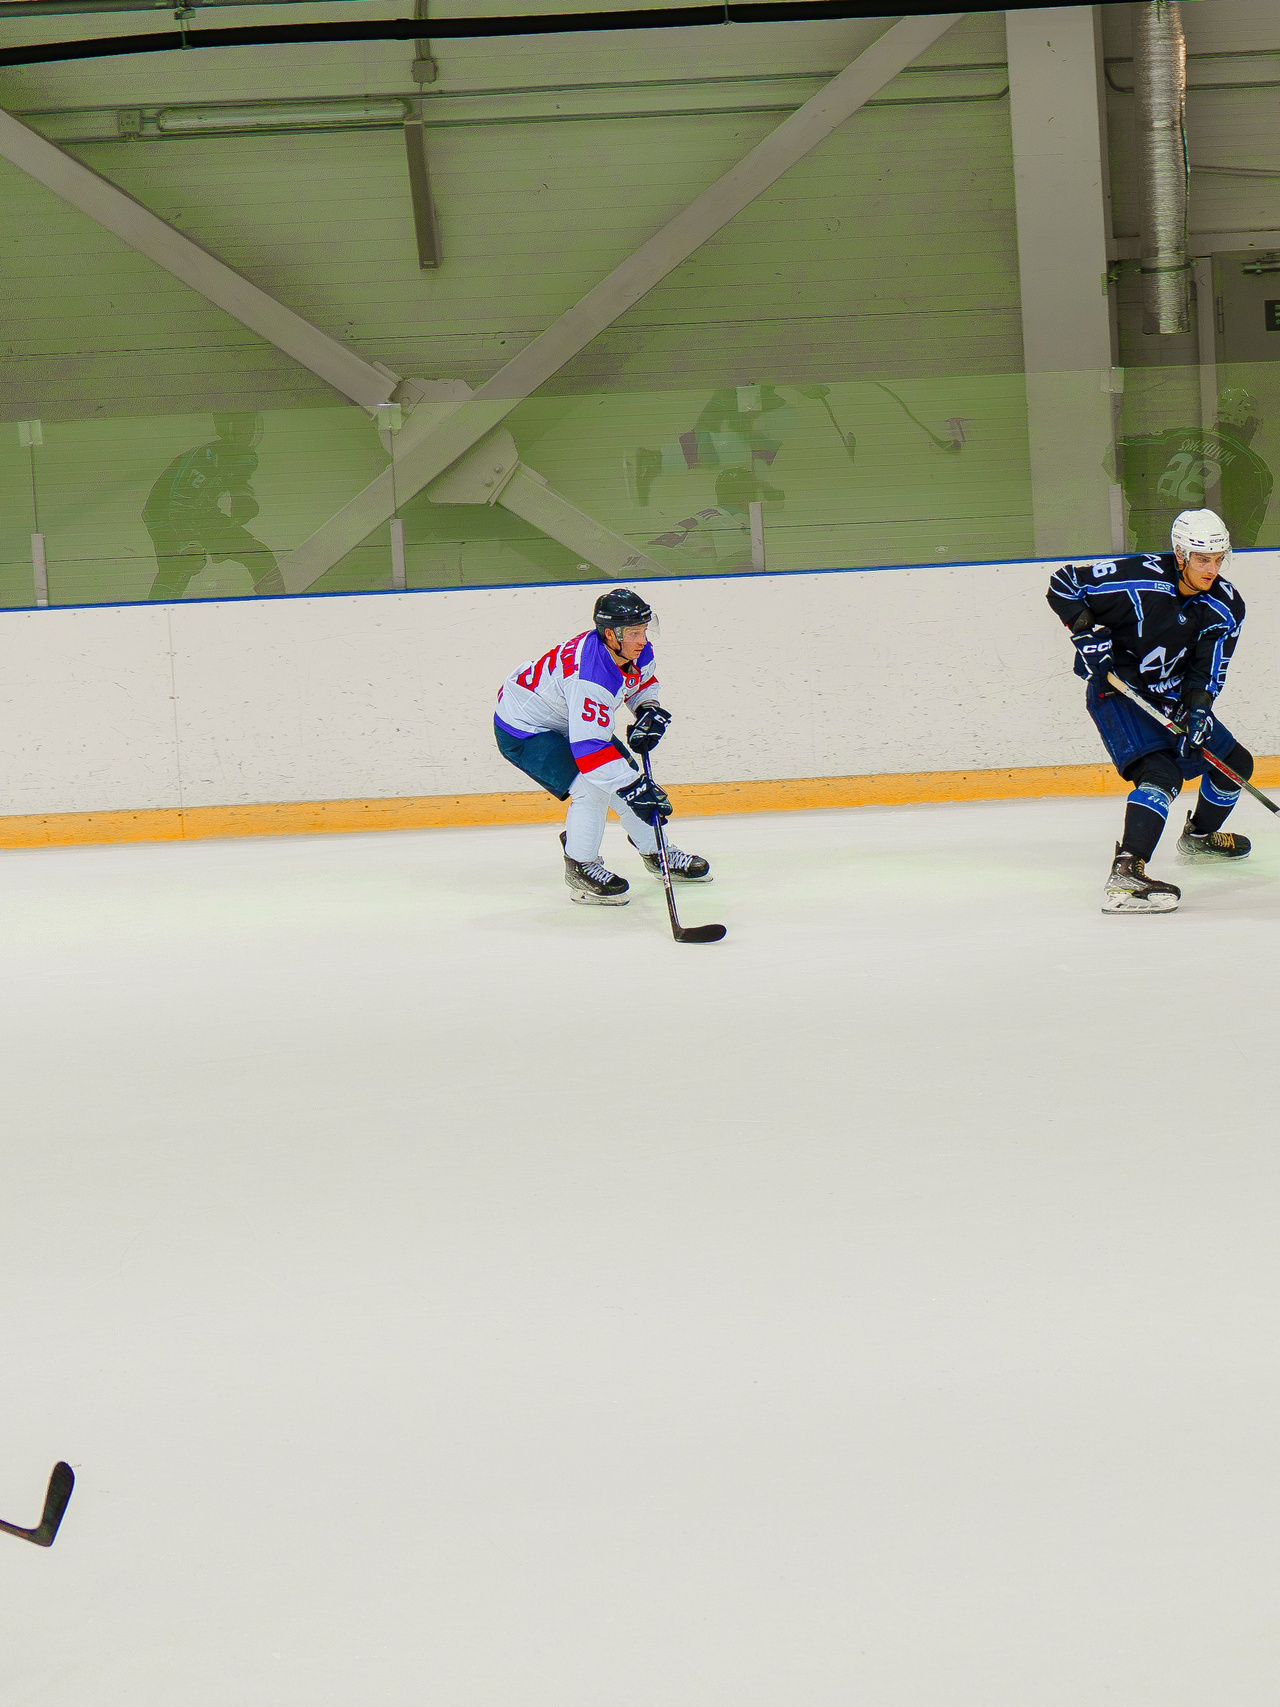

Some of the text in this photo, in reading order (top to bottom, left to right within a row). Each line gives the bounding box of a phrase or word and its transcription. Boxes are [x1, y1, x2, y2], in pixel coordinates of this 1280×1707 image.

[1092, 562, 1117, 578] 6
[516, 644, 561, 692] 5
[581, 697, 610, 728] 55
[622, 782, 648, 802] CM
